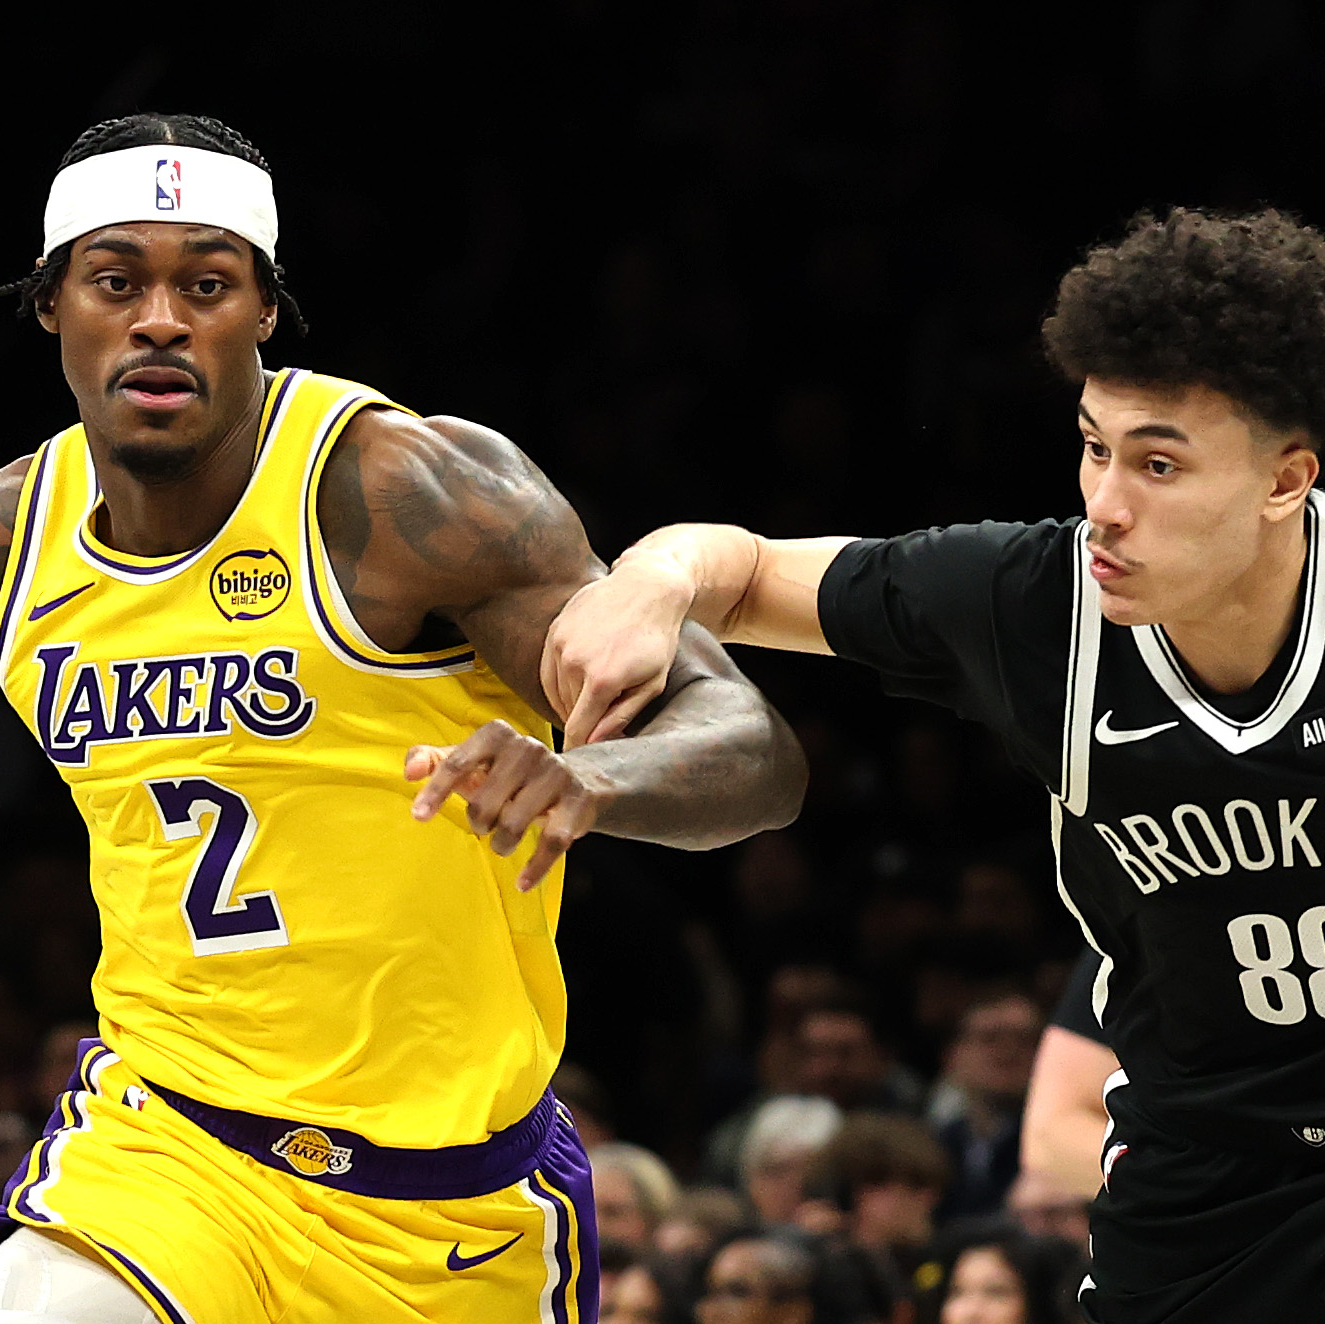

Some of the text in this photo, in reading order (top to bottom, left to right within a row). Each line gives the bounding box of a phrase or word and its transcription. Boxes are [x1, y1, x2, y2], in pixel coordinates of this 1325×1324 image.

[217, 568, 286, 599] bibigo
[32, 641, 317, 767] LAKERS
[143, 775, 290, 957] 2
[276, 1134, 350, 1172] LAKERS
